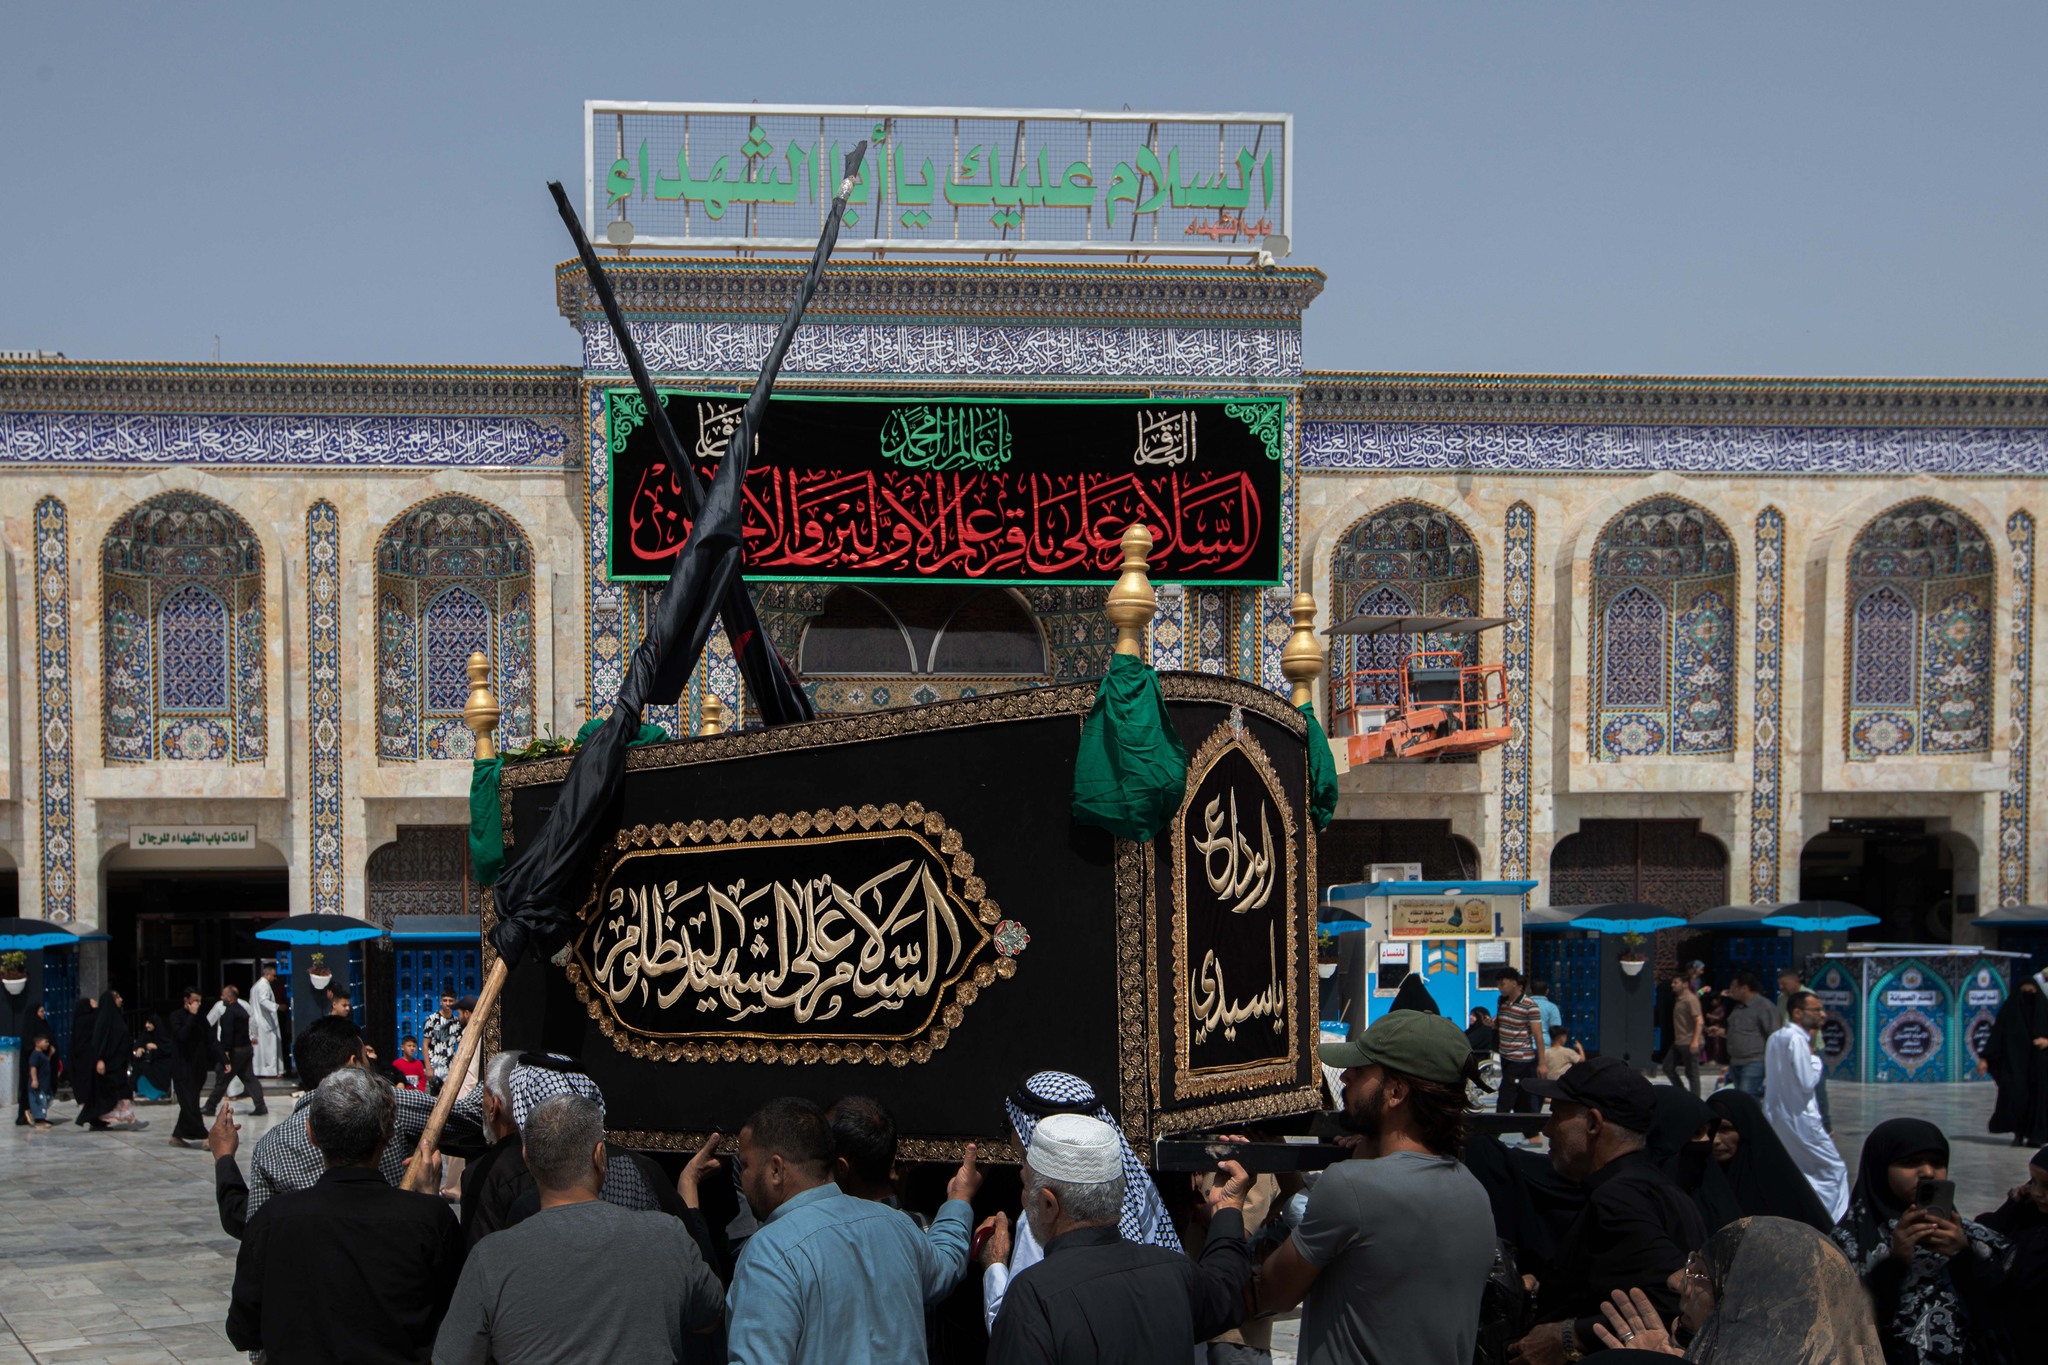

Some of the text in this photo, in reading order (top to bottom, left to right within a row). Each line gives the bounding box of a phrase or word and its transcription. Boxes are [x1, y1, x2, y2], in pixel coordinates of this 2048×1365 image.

[606, 124, 818, 221] الشهداء
[944, 142, 1098, 230] عليك
[1105, 143, 1273, 230] السلام
[1193, 786, 1276, 913] الوداع
[1382, 949, 1405, 958] للنساء
